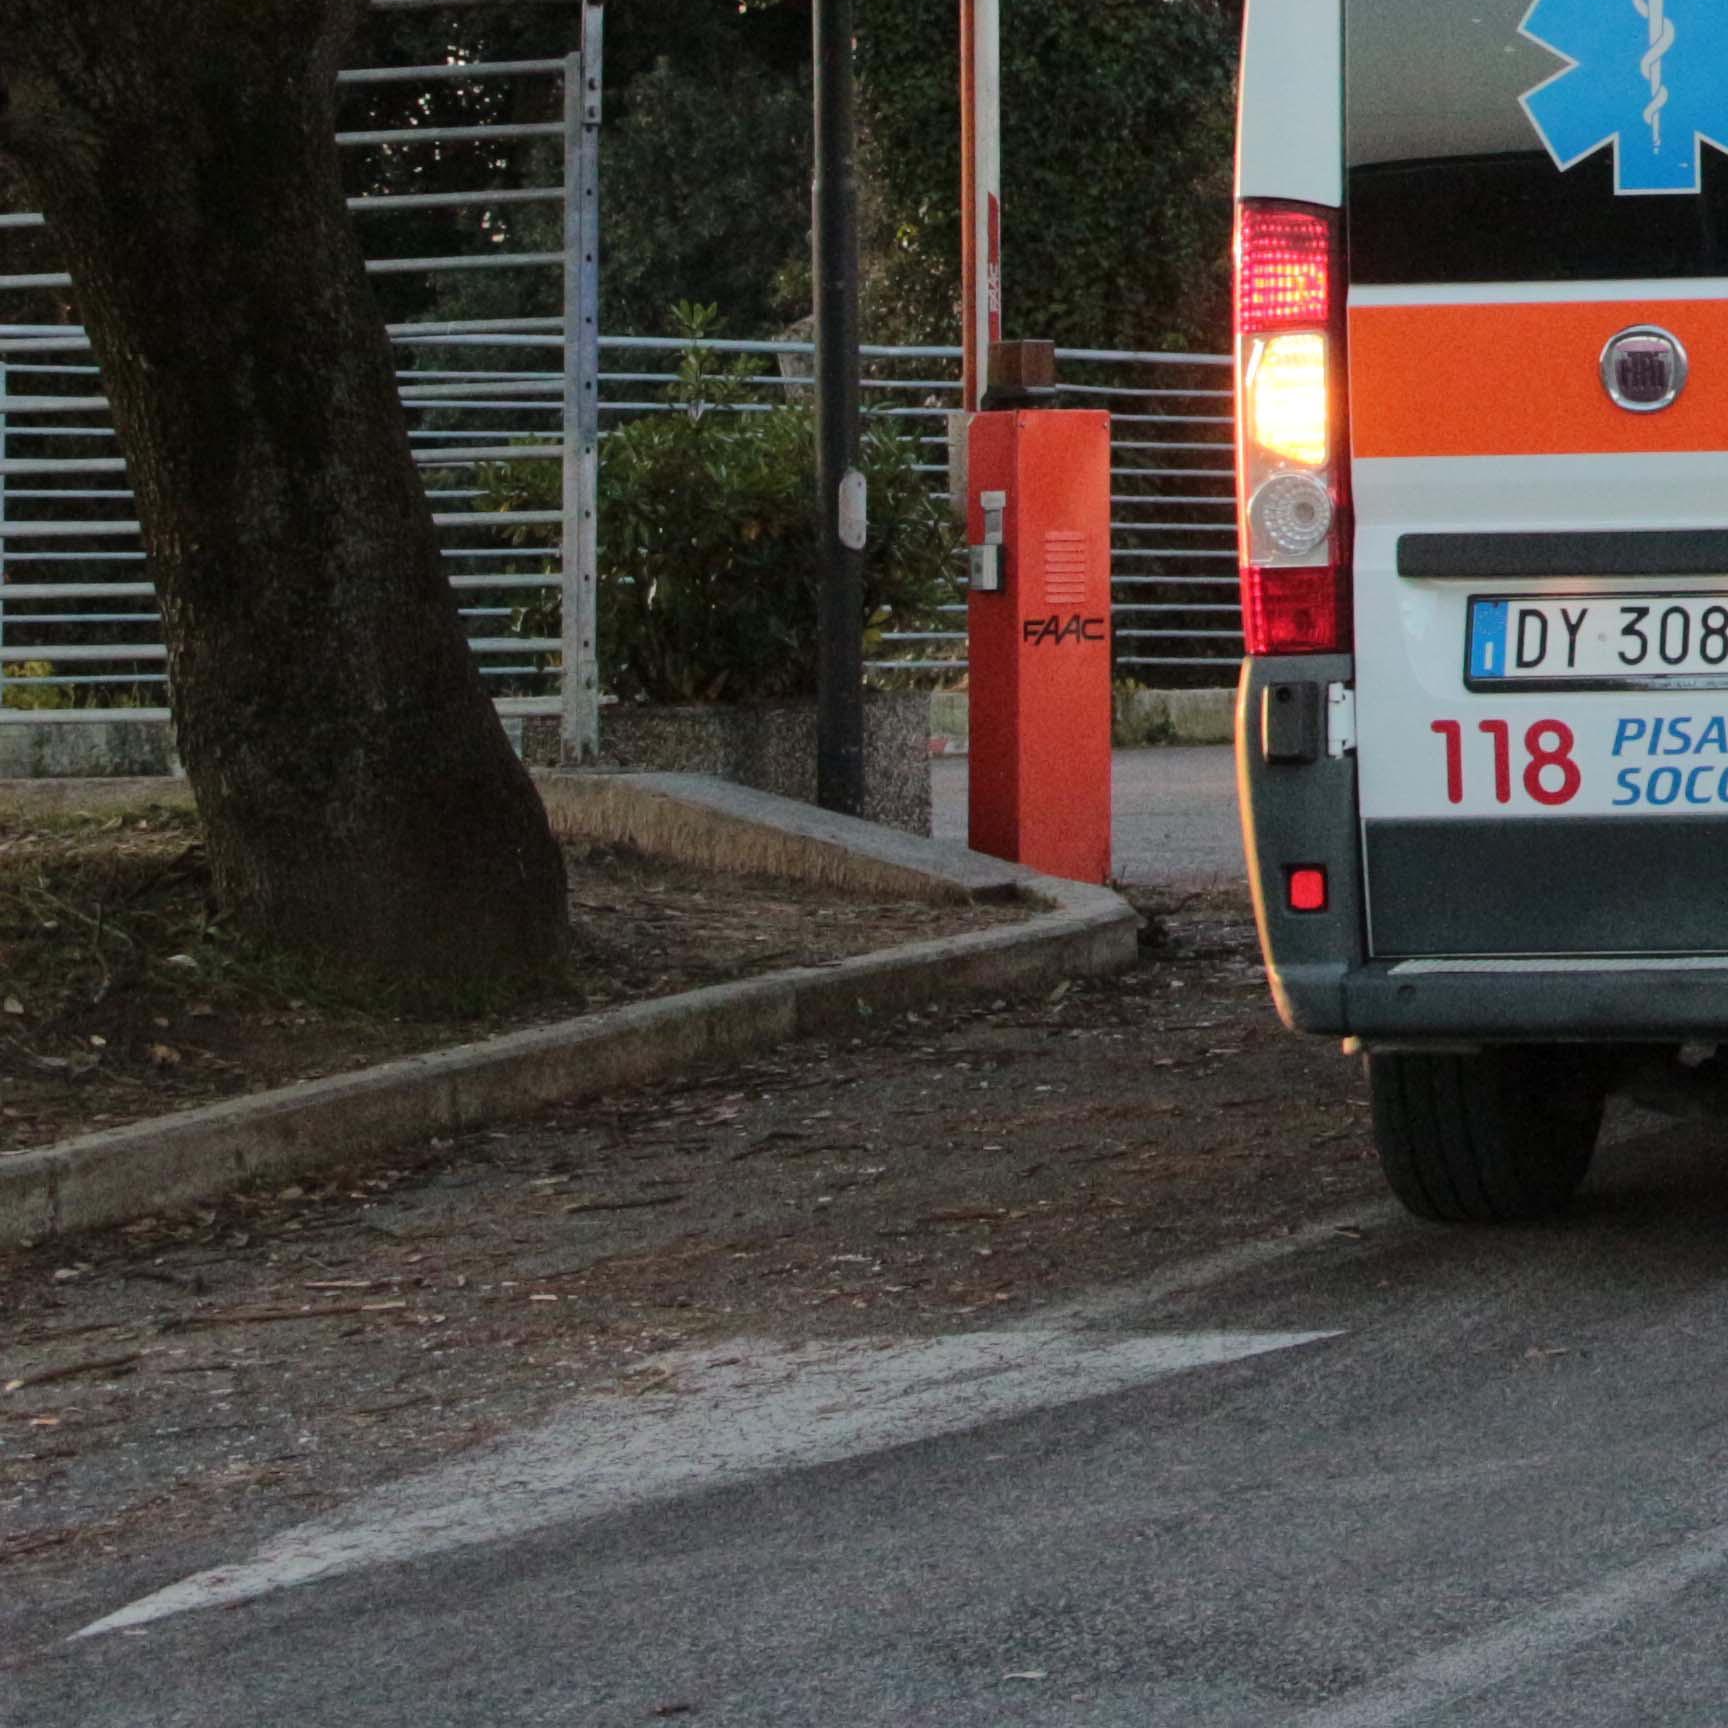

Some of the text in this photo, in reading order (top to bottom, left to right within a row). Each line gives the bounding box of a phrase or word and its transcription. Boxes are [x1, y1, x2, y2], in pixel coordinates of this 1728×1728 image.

[1022, 614, 1106, 647] FAAC
[1514, 607, 1589, 669] DY
[1431, 718, 1582, 806] 118
